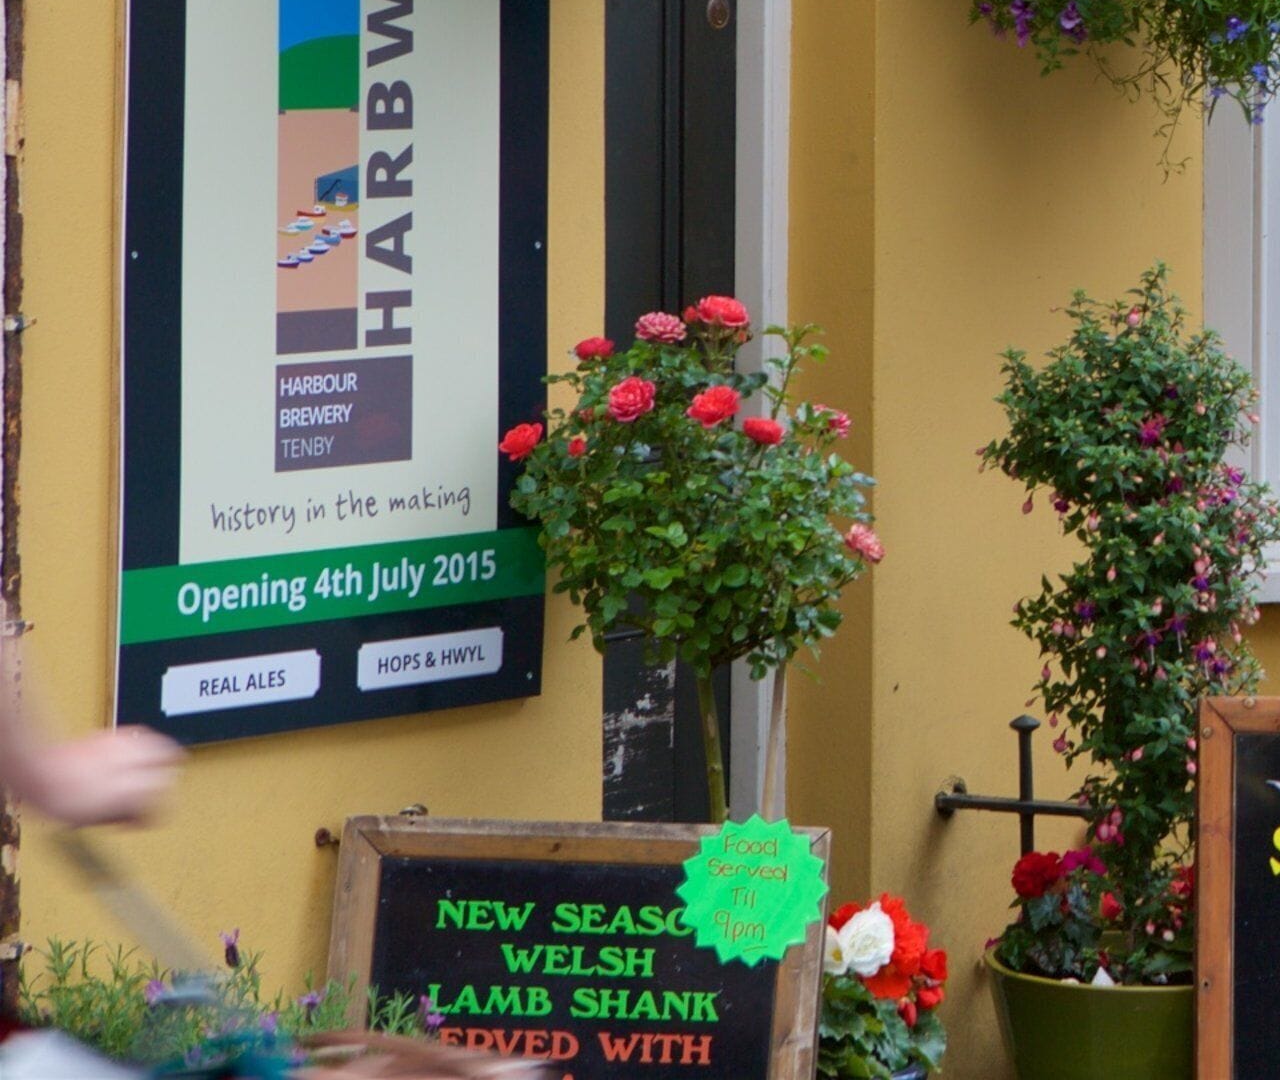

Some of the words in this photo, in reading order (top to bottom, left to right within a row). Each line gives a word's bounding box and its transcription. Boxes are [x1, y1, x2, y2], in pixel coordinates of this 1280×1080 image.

[280, 373, 357, 396] HARBOUR
[280, 404, 353, 428] BREWERY
[281, 436, 334, 458] TENBY
[211, 502, 295, 533] history
[306, 498, 326, 522] in
[335, 490, 378, 518] the
[388, 485, 470, 515] making
[177, 572, 306, 622] Opening
[314, 567, 362, 599] 4th
[368, 559, 426, 601] July
[433, 550, 496, 585] 2015
[377, 653, 420, 675] HOPS
[425, 650, 436, 668] &
[441, 647, 485, 668] HWYL
[200, 673, 241, 697] REAL
[246, 670, 286, 691] ALES
[724, 833, 778, 857] Food
[708, 857, 788, 882] Served
[435, 899, 534, 931] NEW
[714, 910, 765, 942] 9pm
[501, 943, 654, 977] WELSH
[427, 984, 551, 1017] LAMB
[570, 988, 719, 1022] SHANK
[599, 1032, 712, 1065] WITH
